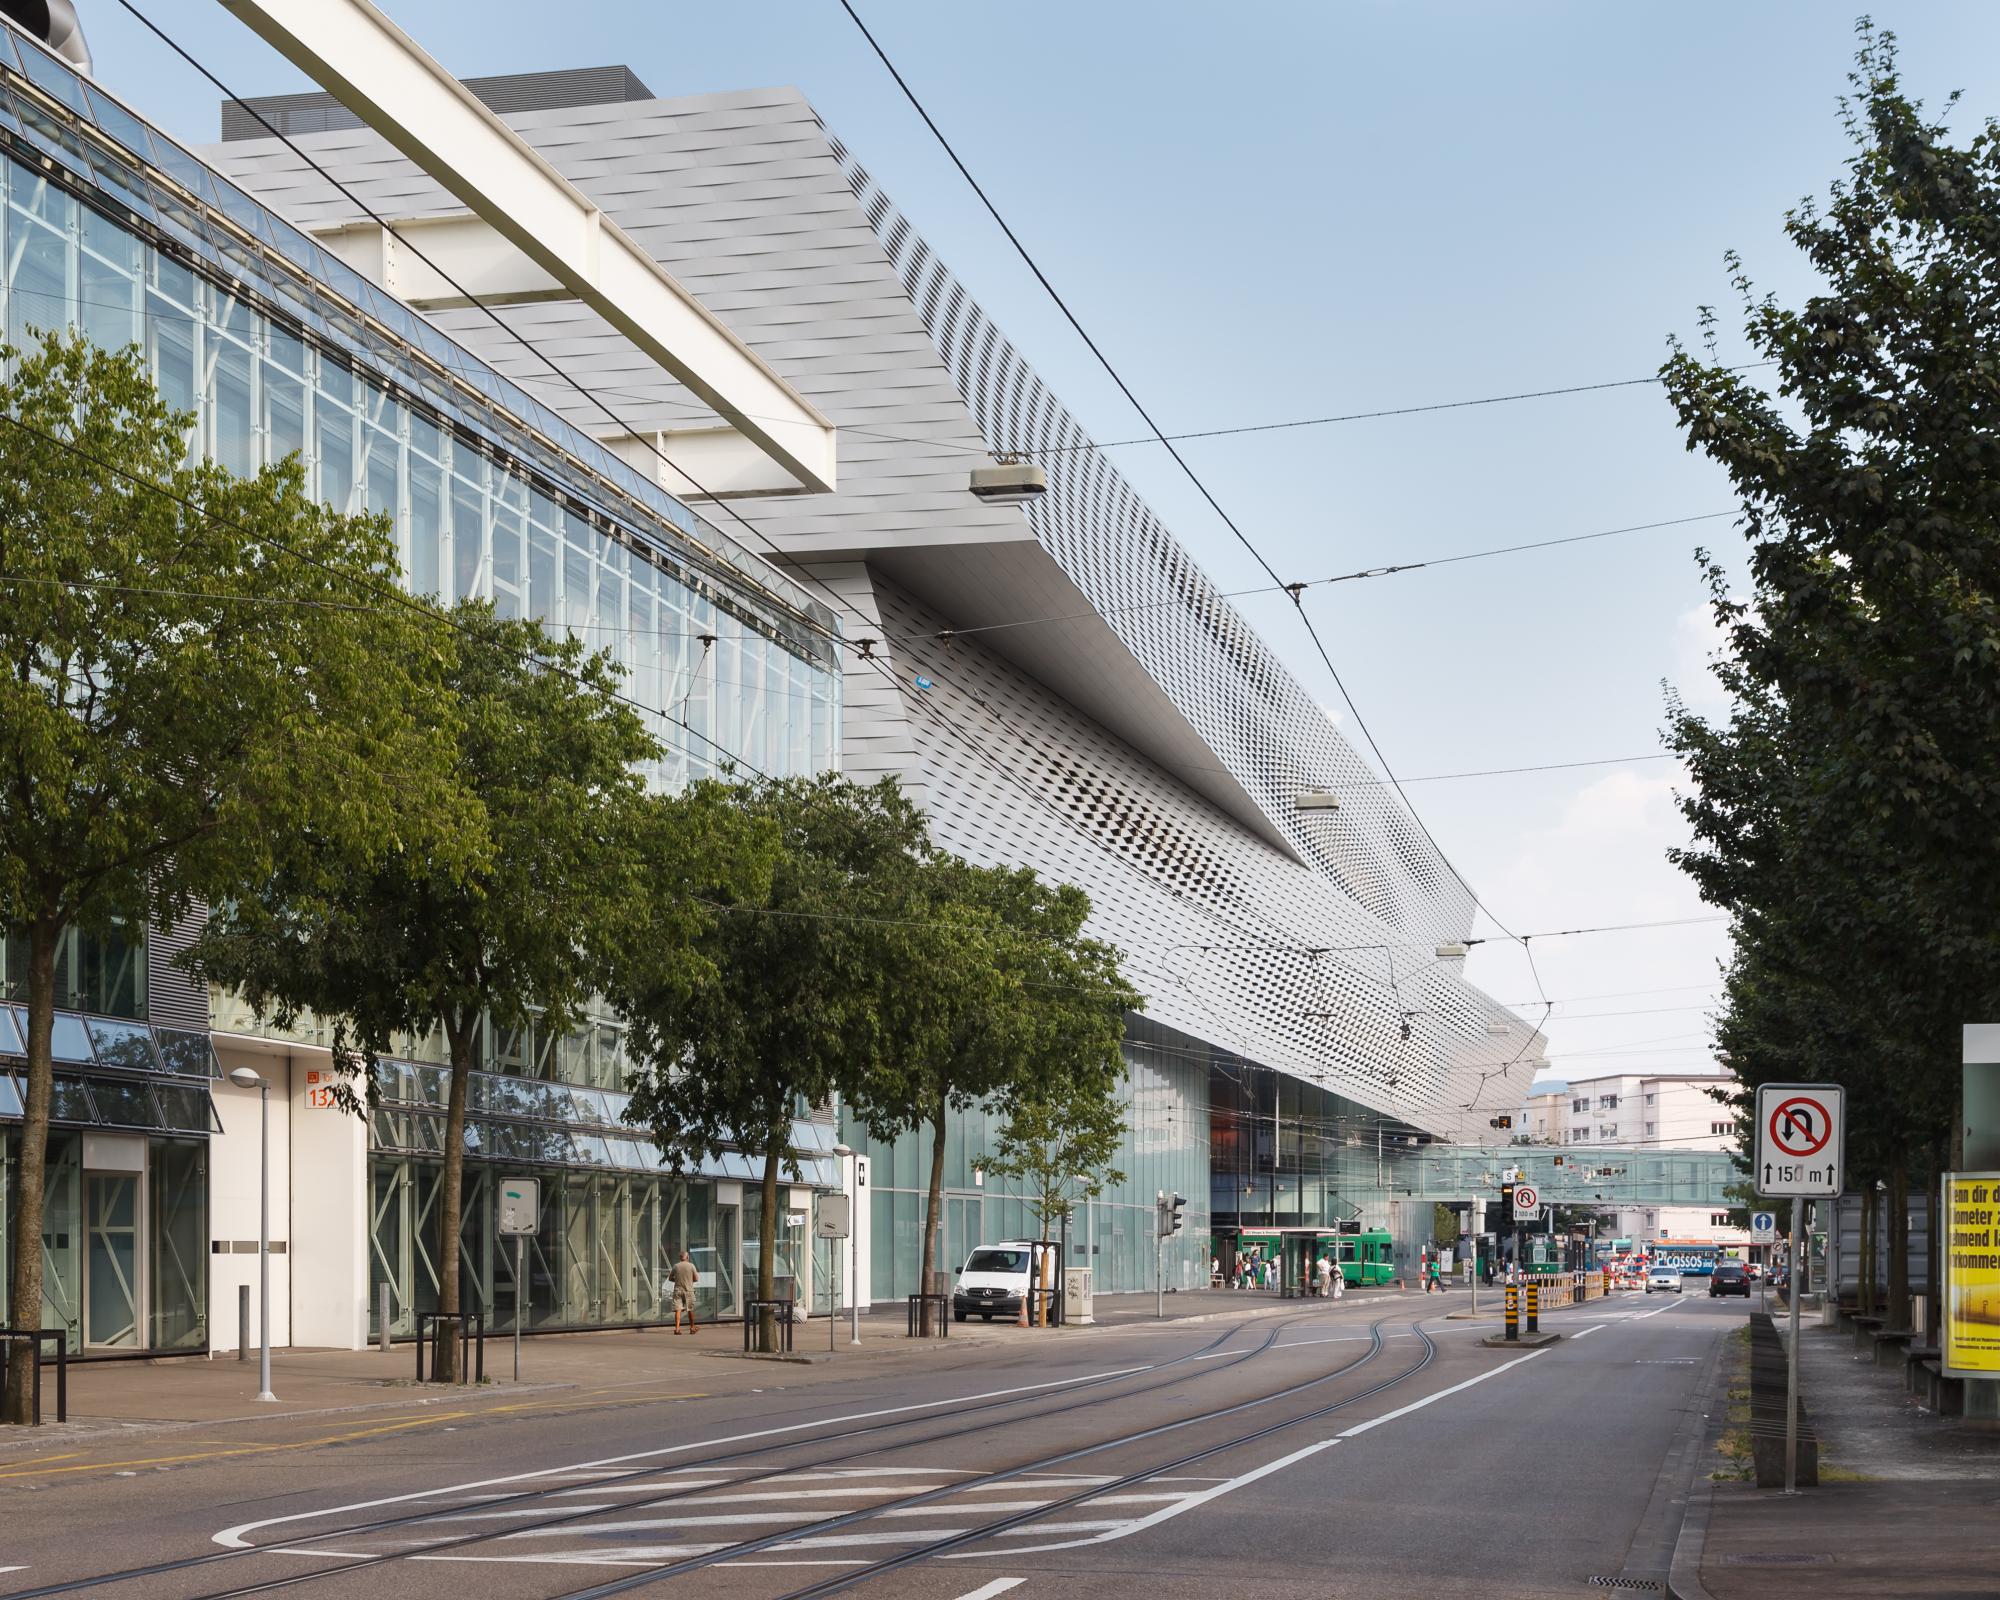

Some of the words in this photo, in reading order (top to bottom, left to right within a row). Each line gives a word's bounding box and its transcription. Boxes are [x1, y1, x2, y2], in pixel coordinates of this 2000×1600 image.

[1506, 1173, 1512, 1181] S
[1778, 1166, 1804, 1182] 150
[1809, 1170, 1822, 1182] m
[1972, 1185, 1988, 1203] dir
[1657, 1250, 1703, 1268] Picassos
